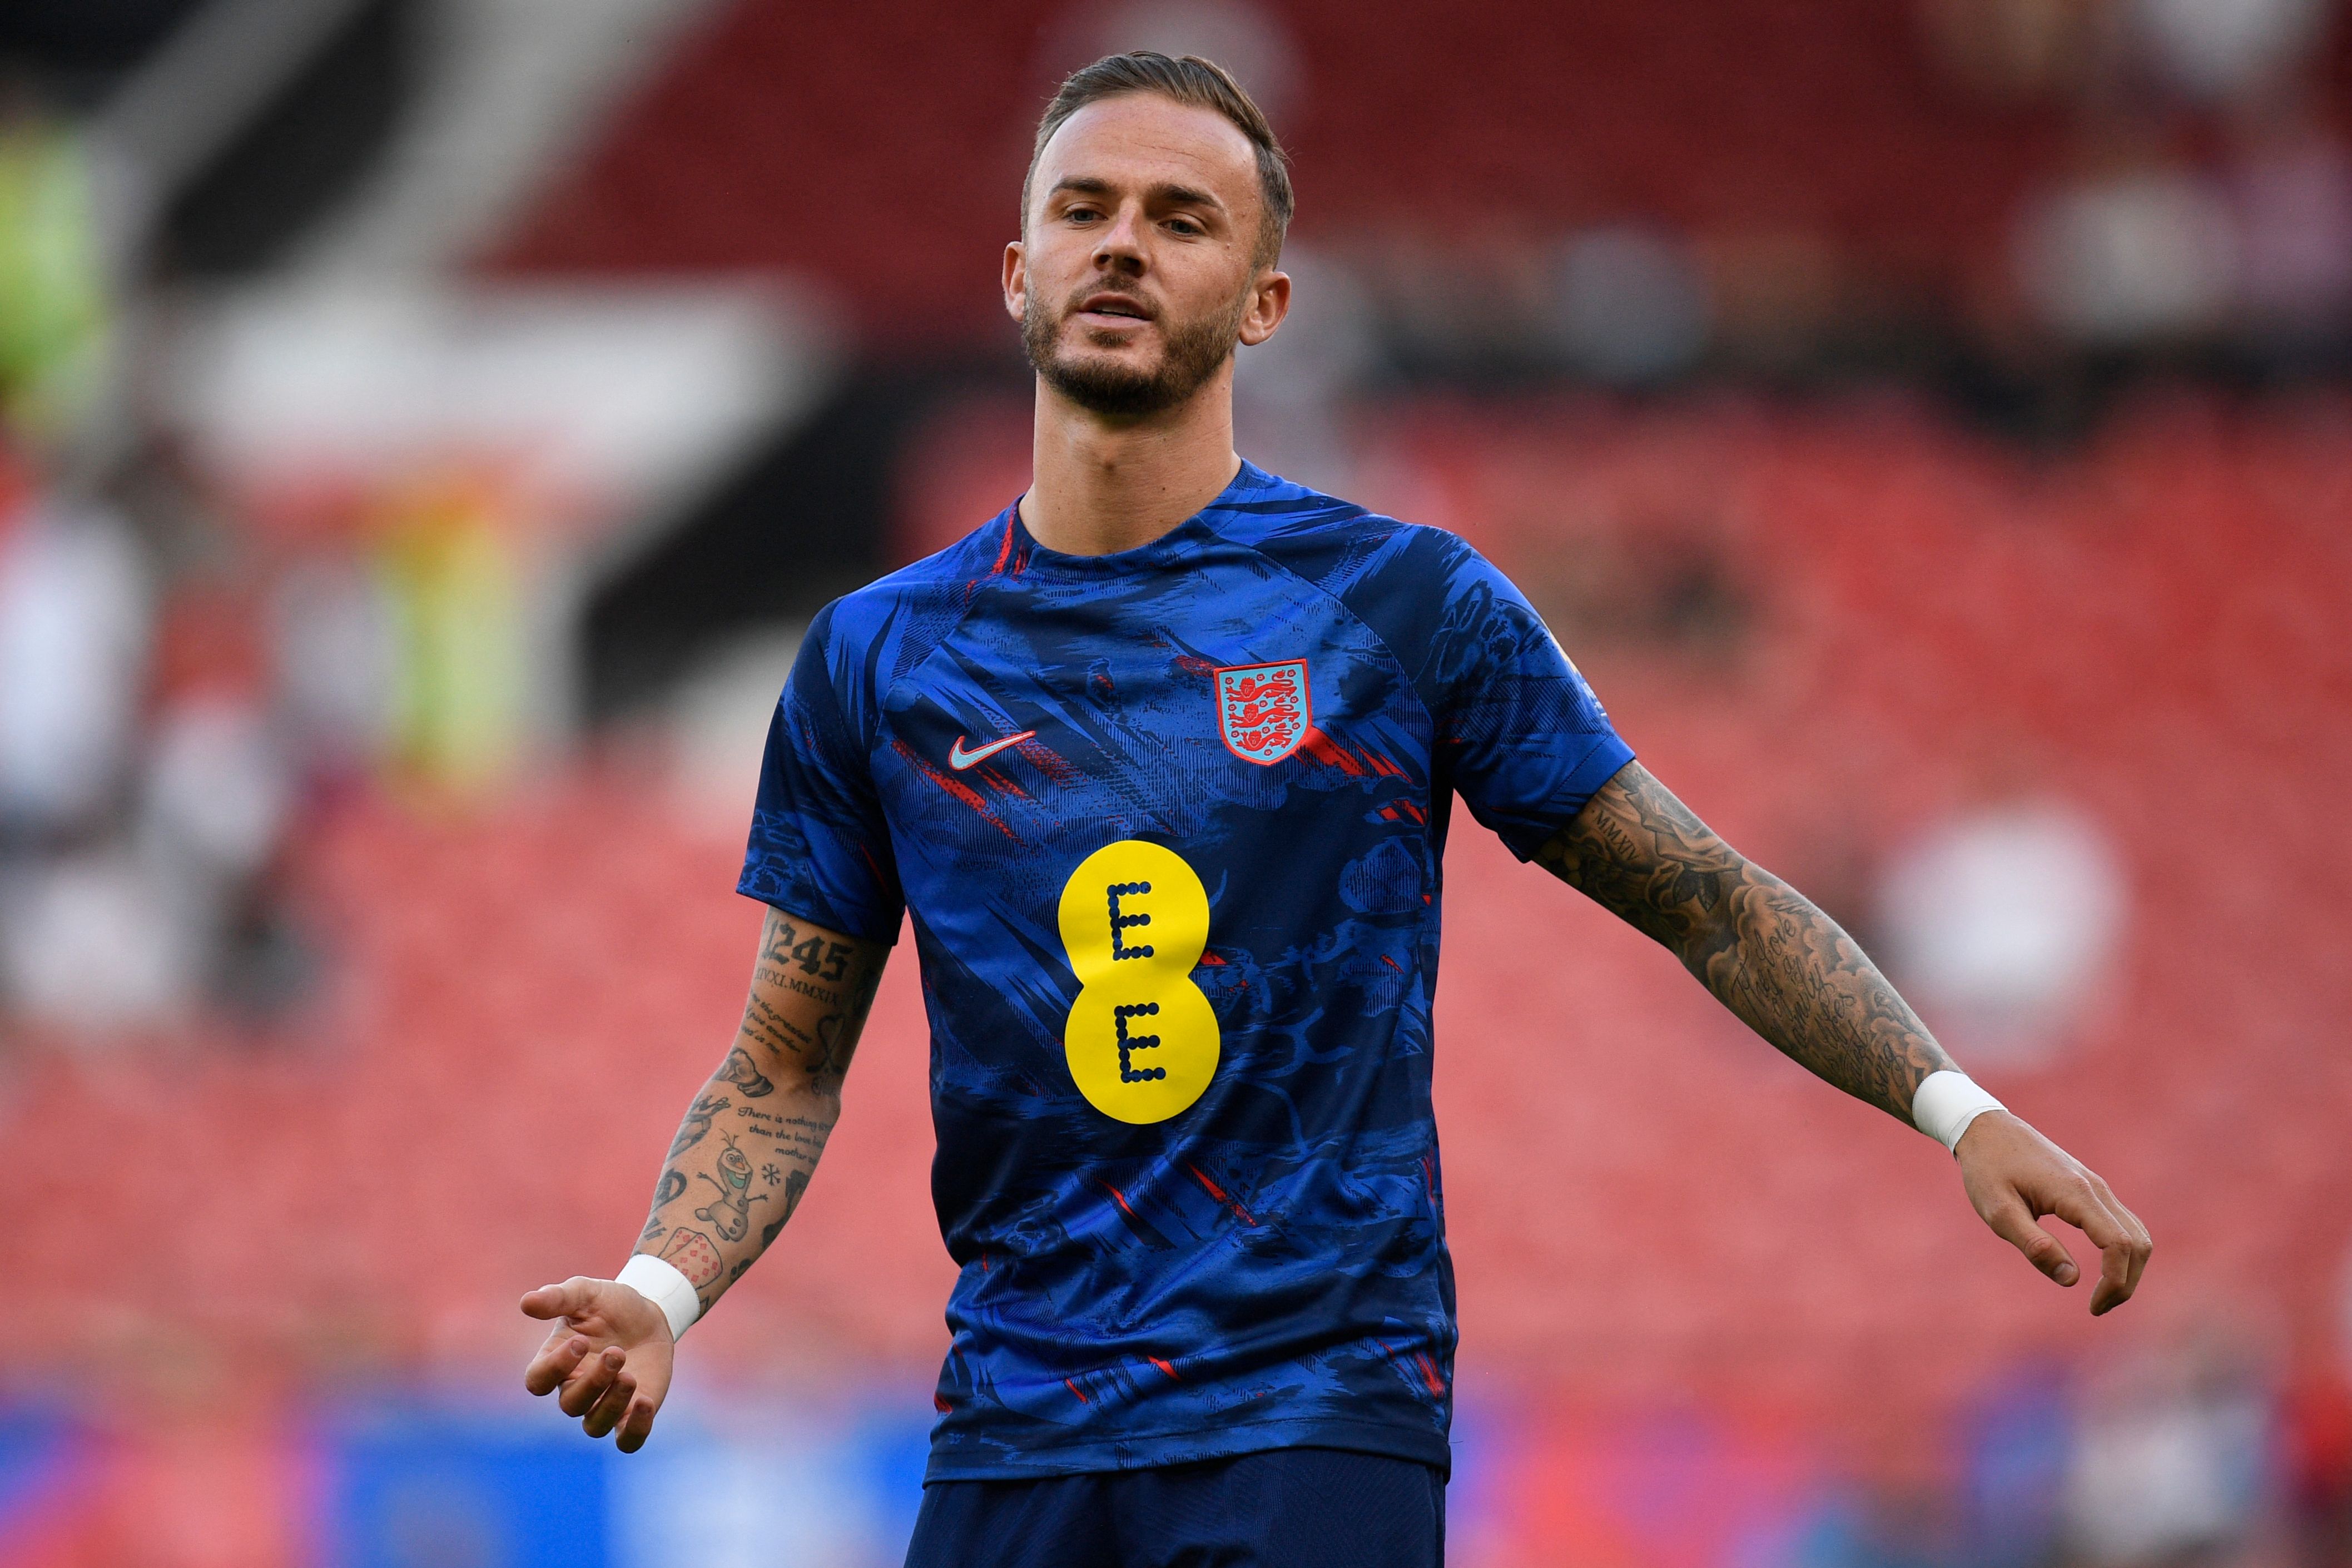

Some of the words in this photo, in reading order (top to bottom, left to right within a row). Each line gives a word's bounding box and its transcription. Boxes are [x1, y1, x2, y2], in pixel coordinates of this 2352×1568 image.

[1106, 881, 1152, 961] E
[761, 919, 854, 982] 1245
[1114, 1002, 1166, 1084] E
[737, 1106, 771, 1121] There
[774, 1113, 782, 1123] is
[786, 1115, 817, 1132] nothing
[749, 1124, 772, 1138] than
[776, 1129, 791, 1140] the
[775, 1148, 807, 1160] mother
